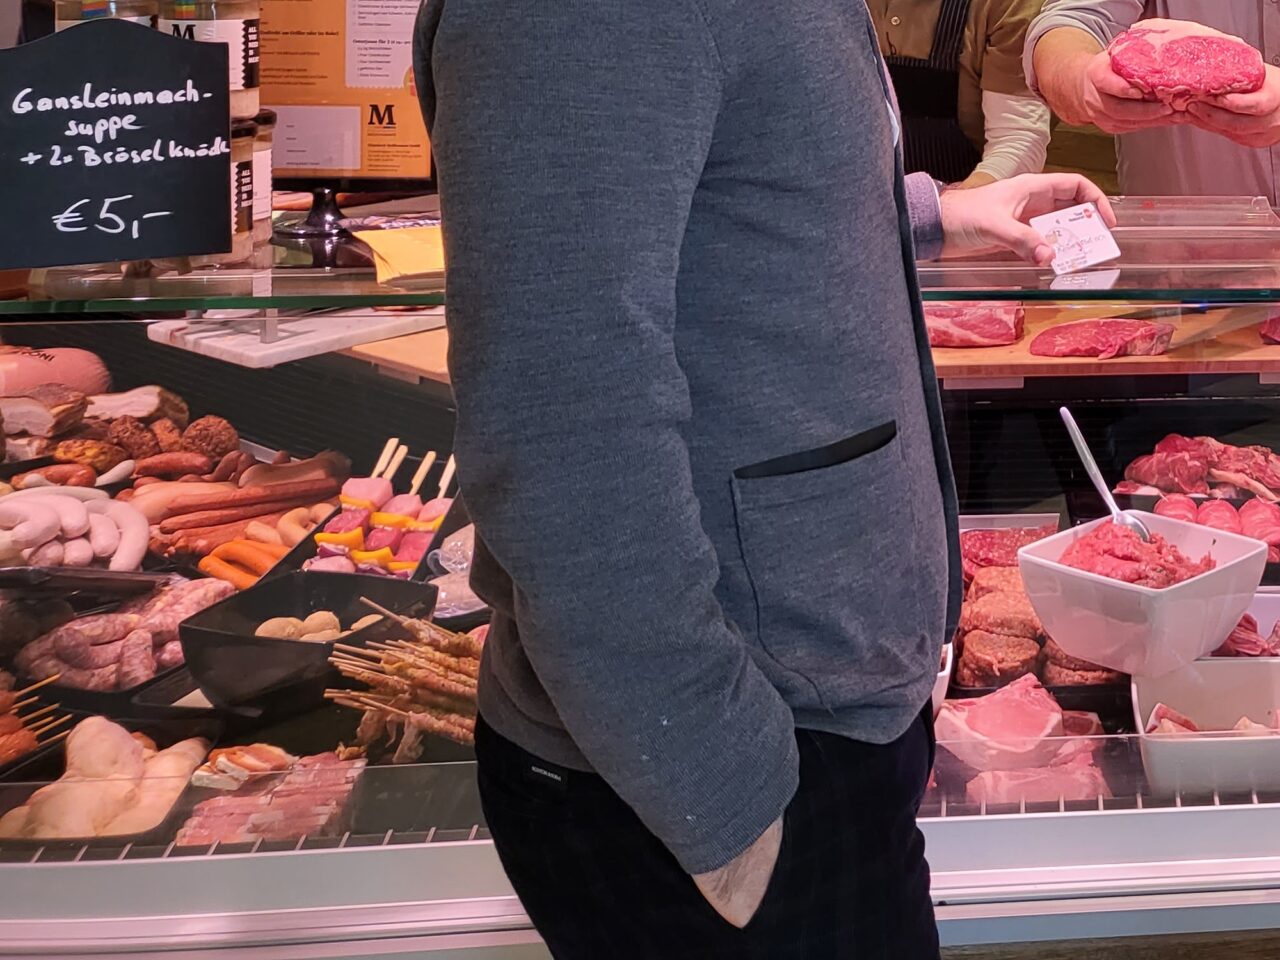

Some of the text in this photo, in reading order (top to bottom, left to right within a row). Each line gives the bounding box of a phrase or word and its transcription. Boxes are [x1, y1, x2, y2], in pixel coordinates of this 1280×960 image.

[172, 24, 196, 41] M
[368, 104, 396, 125] M
[64, 114, 143, 143] suppe
